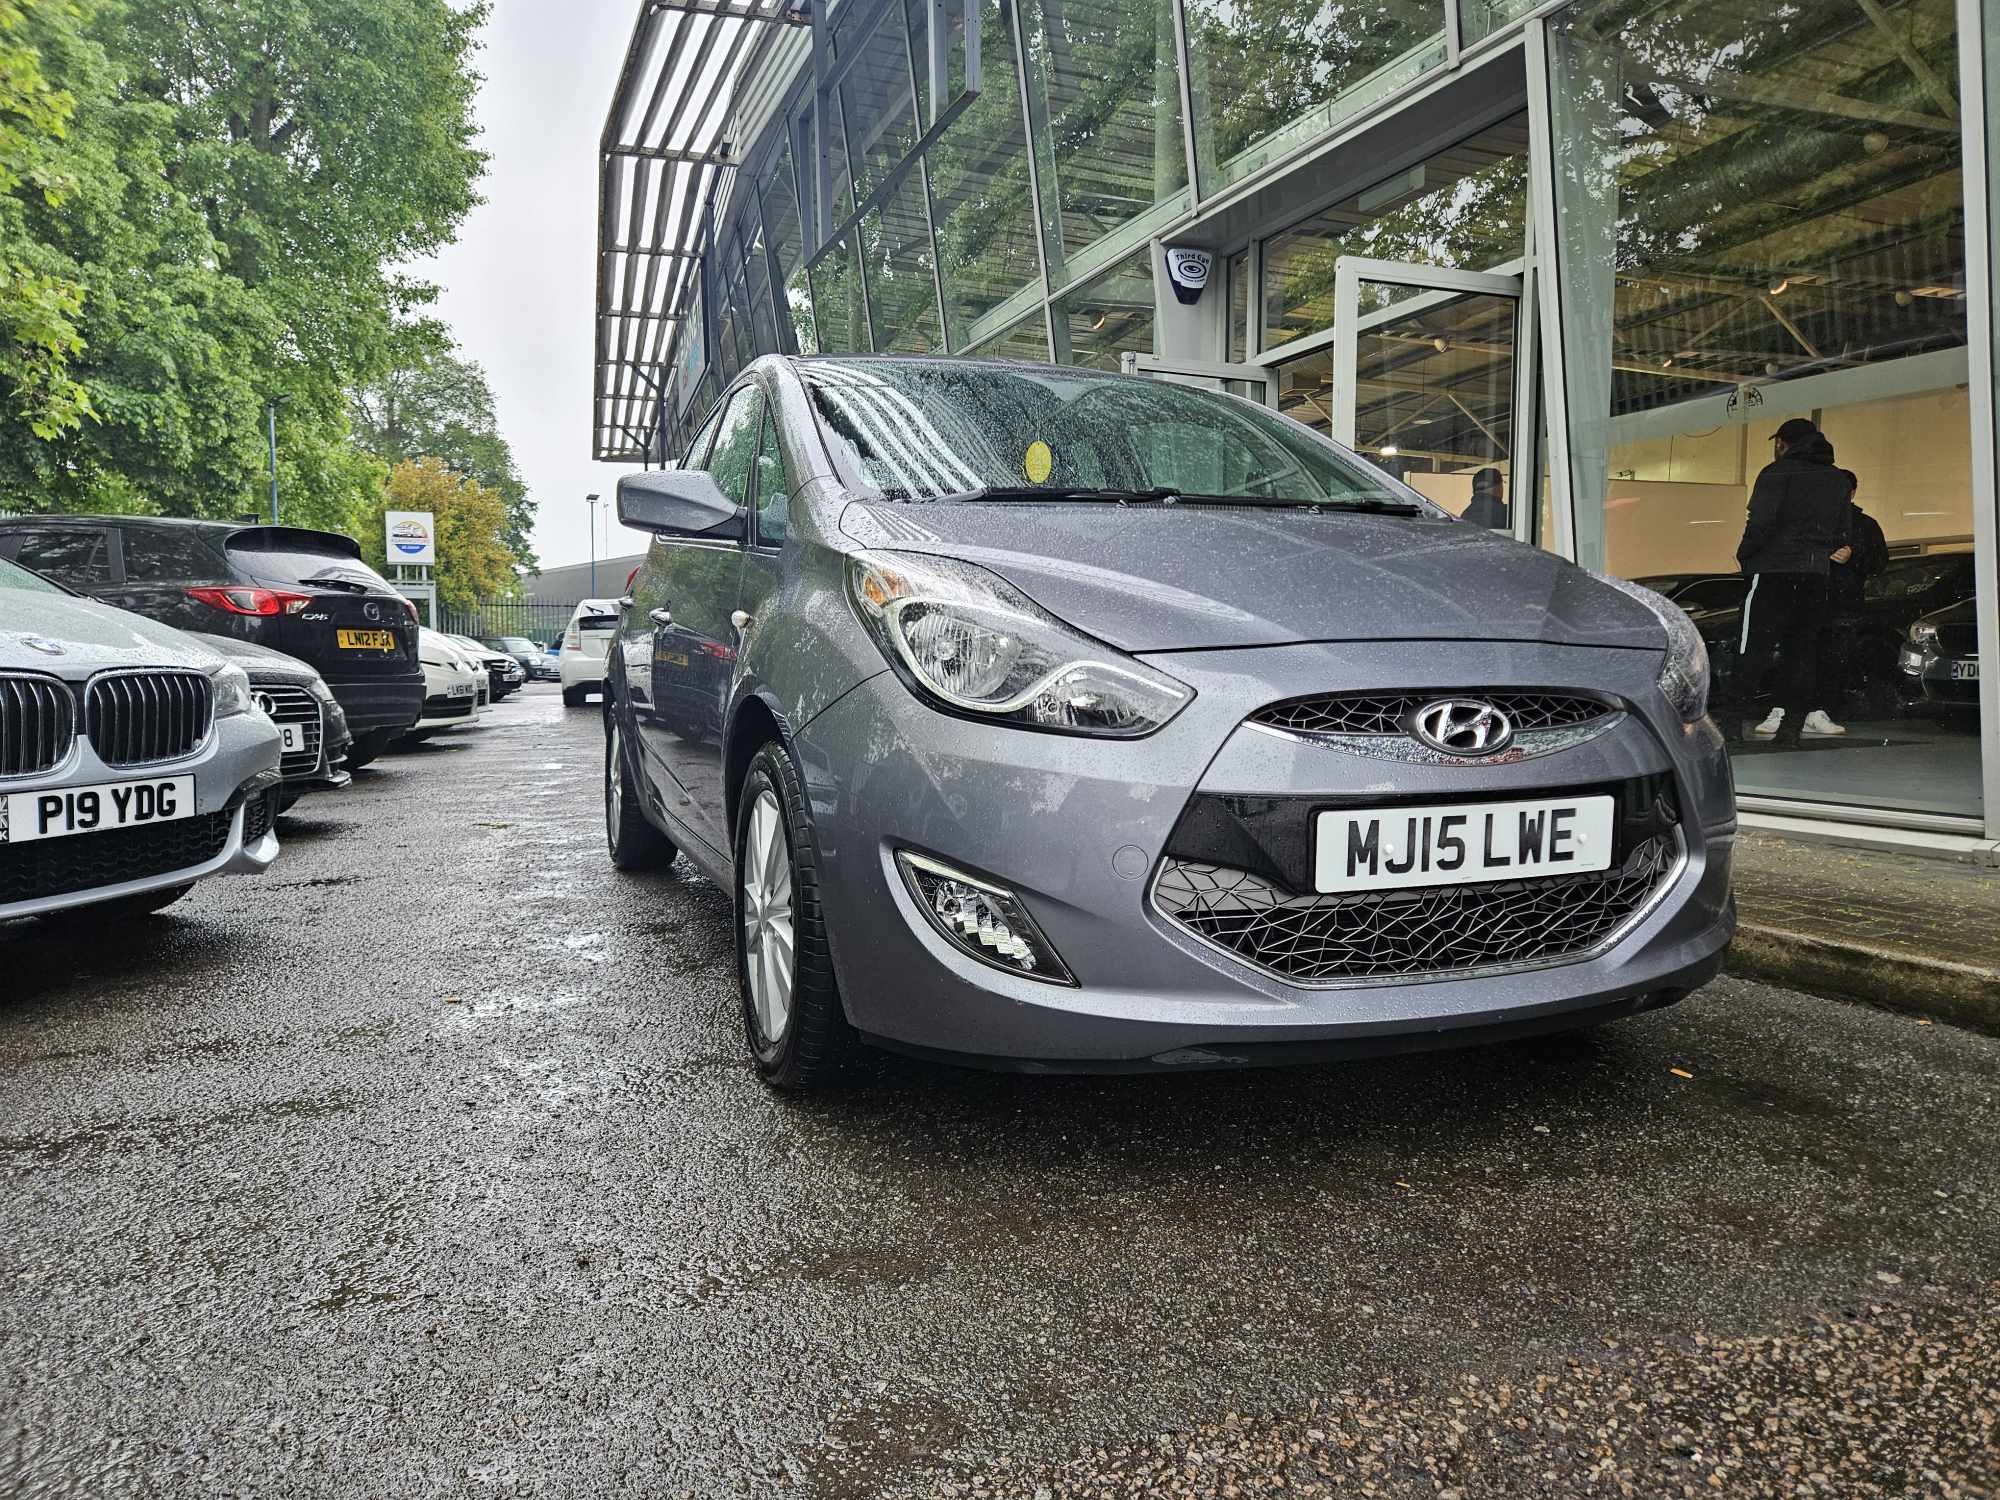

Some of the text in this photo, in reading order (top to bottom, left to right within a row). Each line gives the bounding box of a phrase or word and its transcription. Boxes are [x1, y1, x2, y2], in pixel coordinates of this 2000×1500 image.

[346, 631, 371, 647] LN12
[1958, 663, 1980, 678] YD
[37, 782, 177, 835] P19 YDG
[1346, 807, 1578, 878] MJ15 LWE
